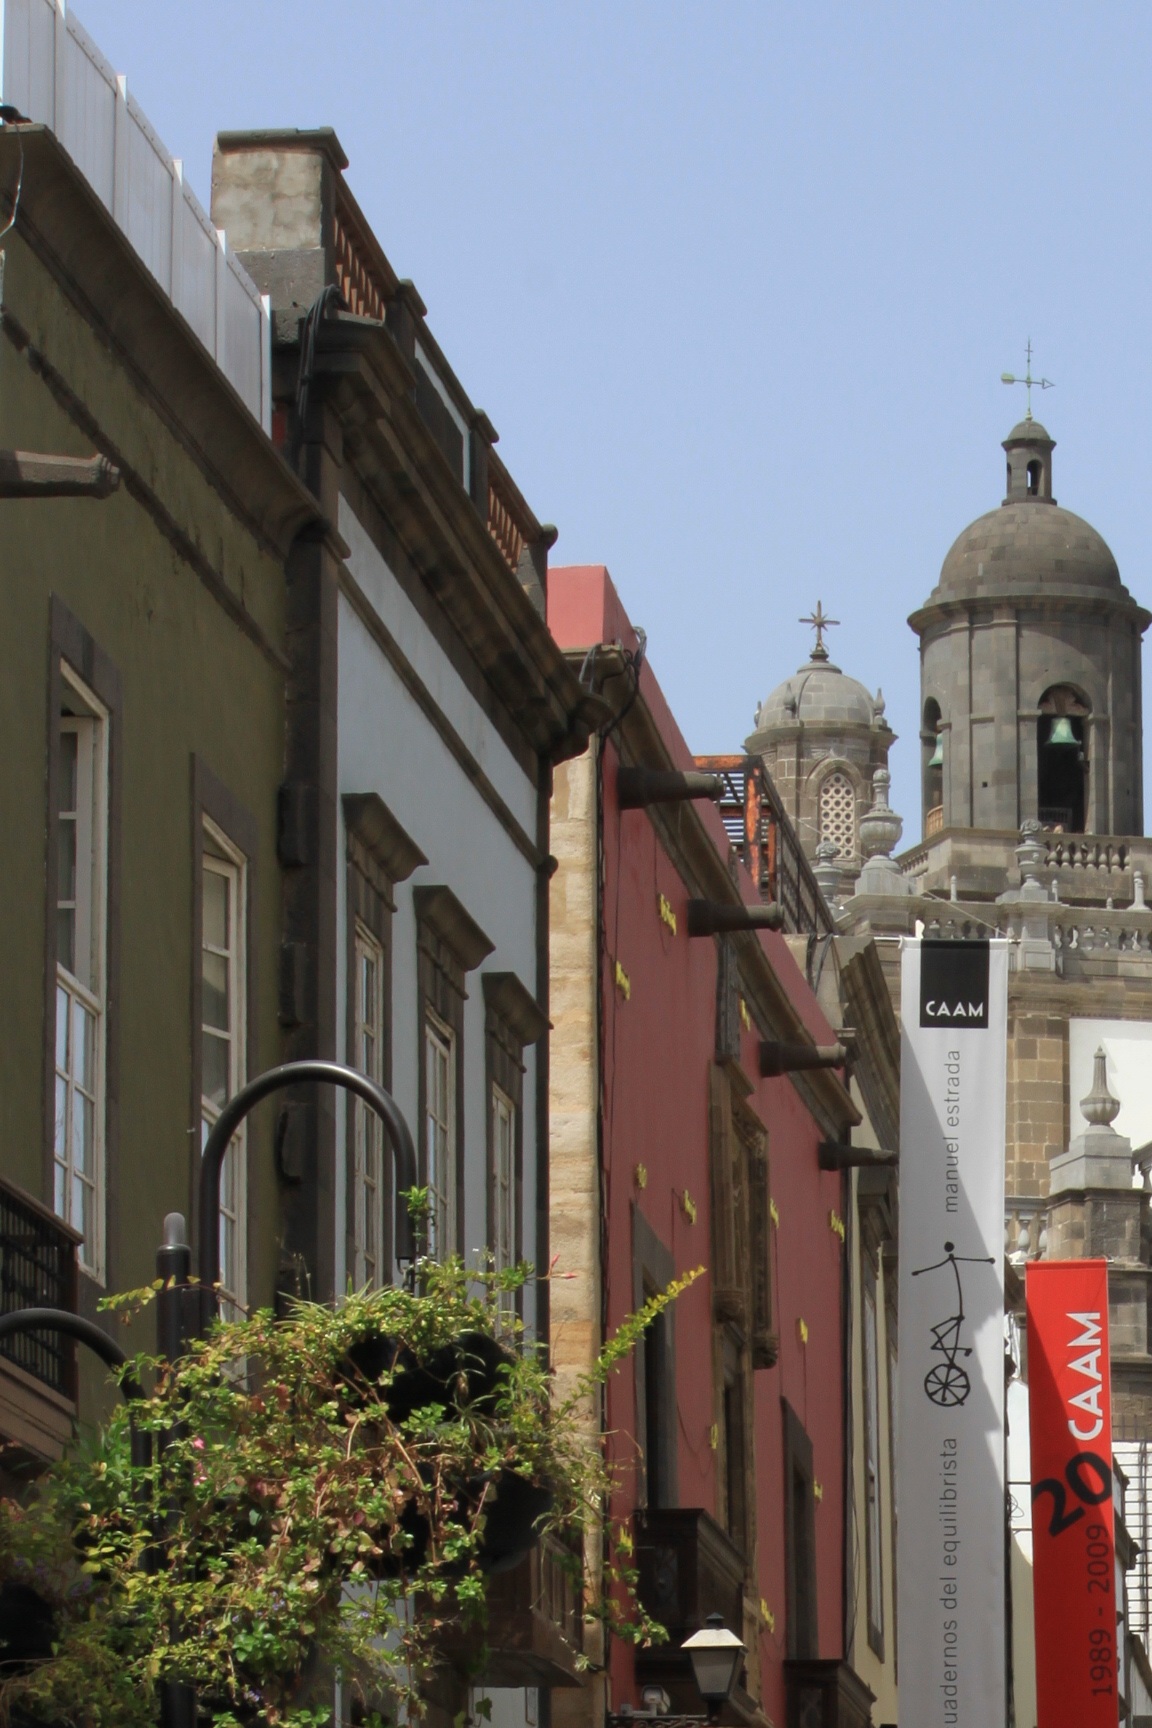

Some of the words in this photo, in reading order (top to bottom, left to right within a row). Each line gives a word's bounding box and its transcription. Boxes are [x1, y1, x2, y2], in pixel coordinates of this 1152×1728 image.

[925, 1000, 984, 1017] CAAM
[943, 1050, 961, 1127] estrada
[943, 1136, 959, 1213] manuel
[1065, 1311, 1104, 1442] CAAM
[939, 1437, 961, 1567] equilibrista
[1033, 1451, 1112, 1538] 20
[939, 1576, 958, 1610] del
[1085, 1524, 1111, 1595] 2009
[1089, 1628, 1113, 1697] 1989
